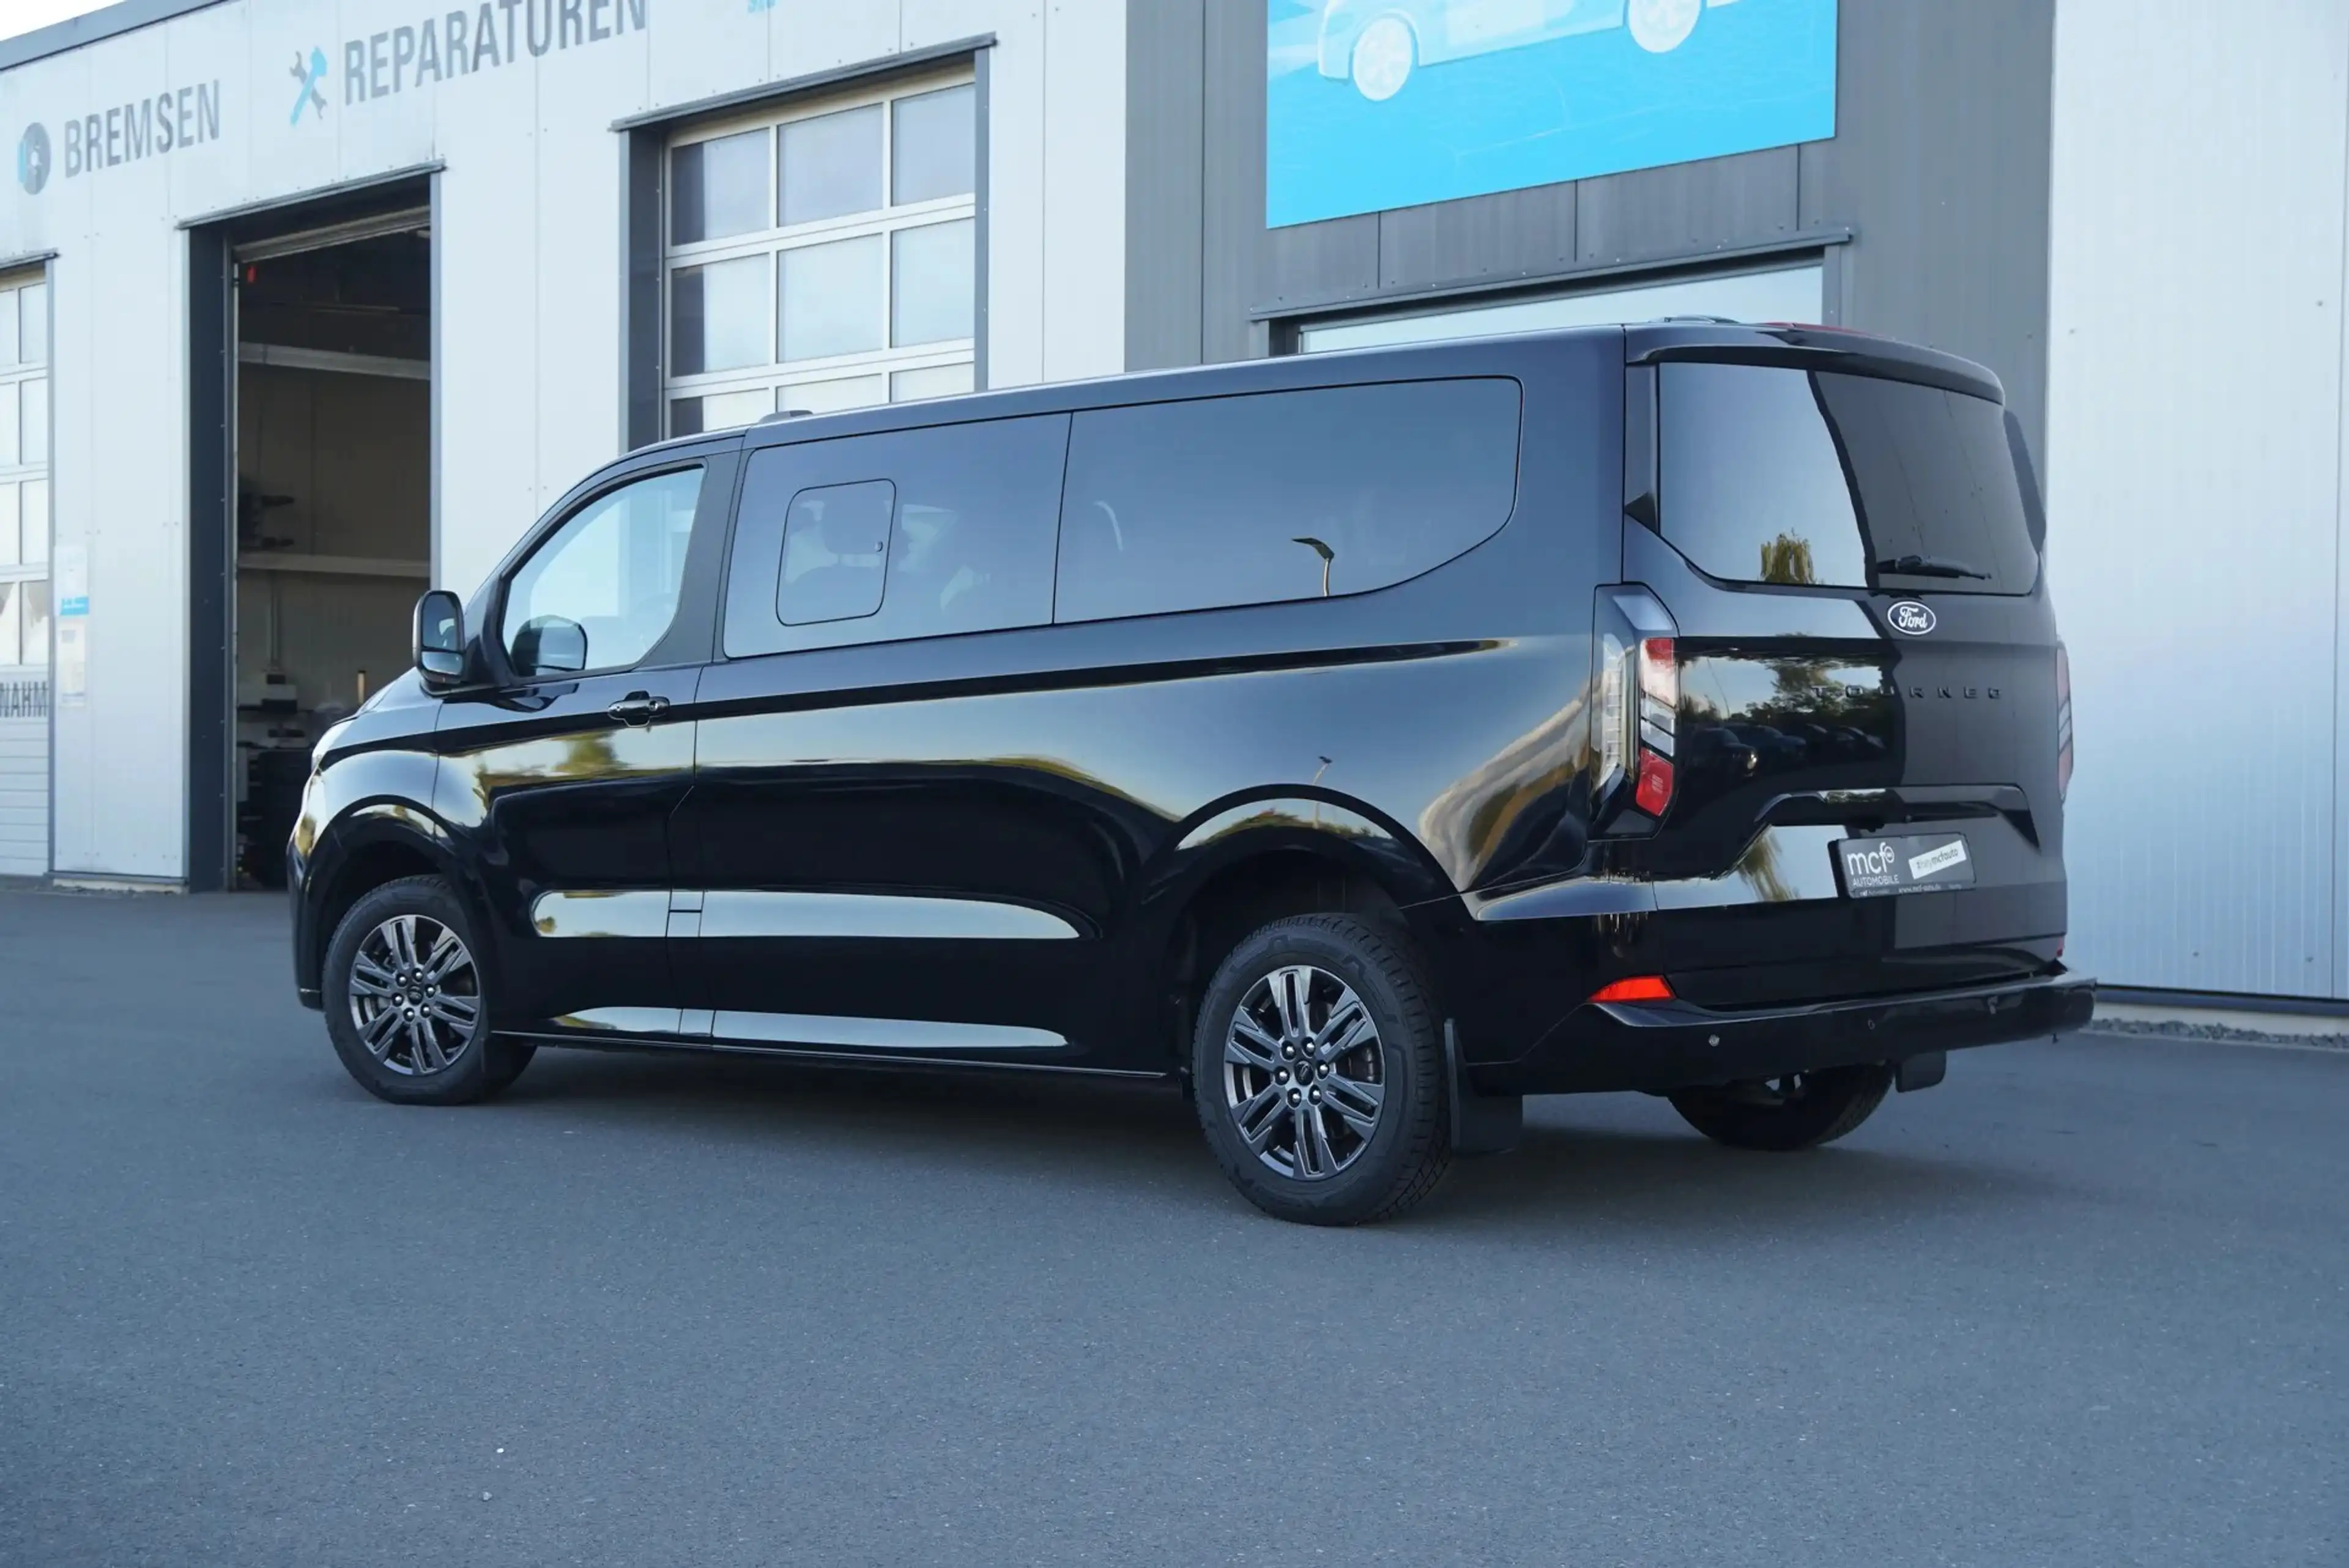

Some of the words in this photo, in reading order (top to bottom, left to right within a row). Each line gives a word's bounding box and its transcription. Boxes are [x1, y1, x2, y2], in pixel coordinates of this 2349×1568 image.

[64, 79, 219, 178] BREMSEN
[1898, 606, 1928, 629] Ford
[1811, 684, 2002, 700] TOURNEO
[1852, 875, 1899, 887] AUTOMOBILE
